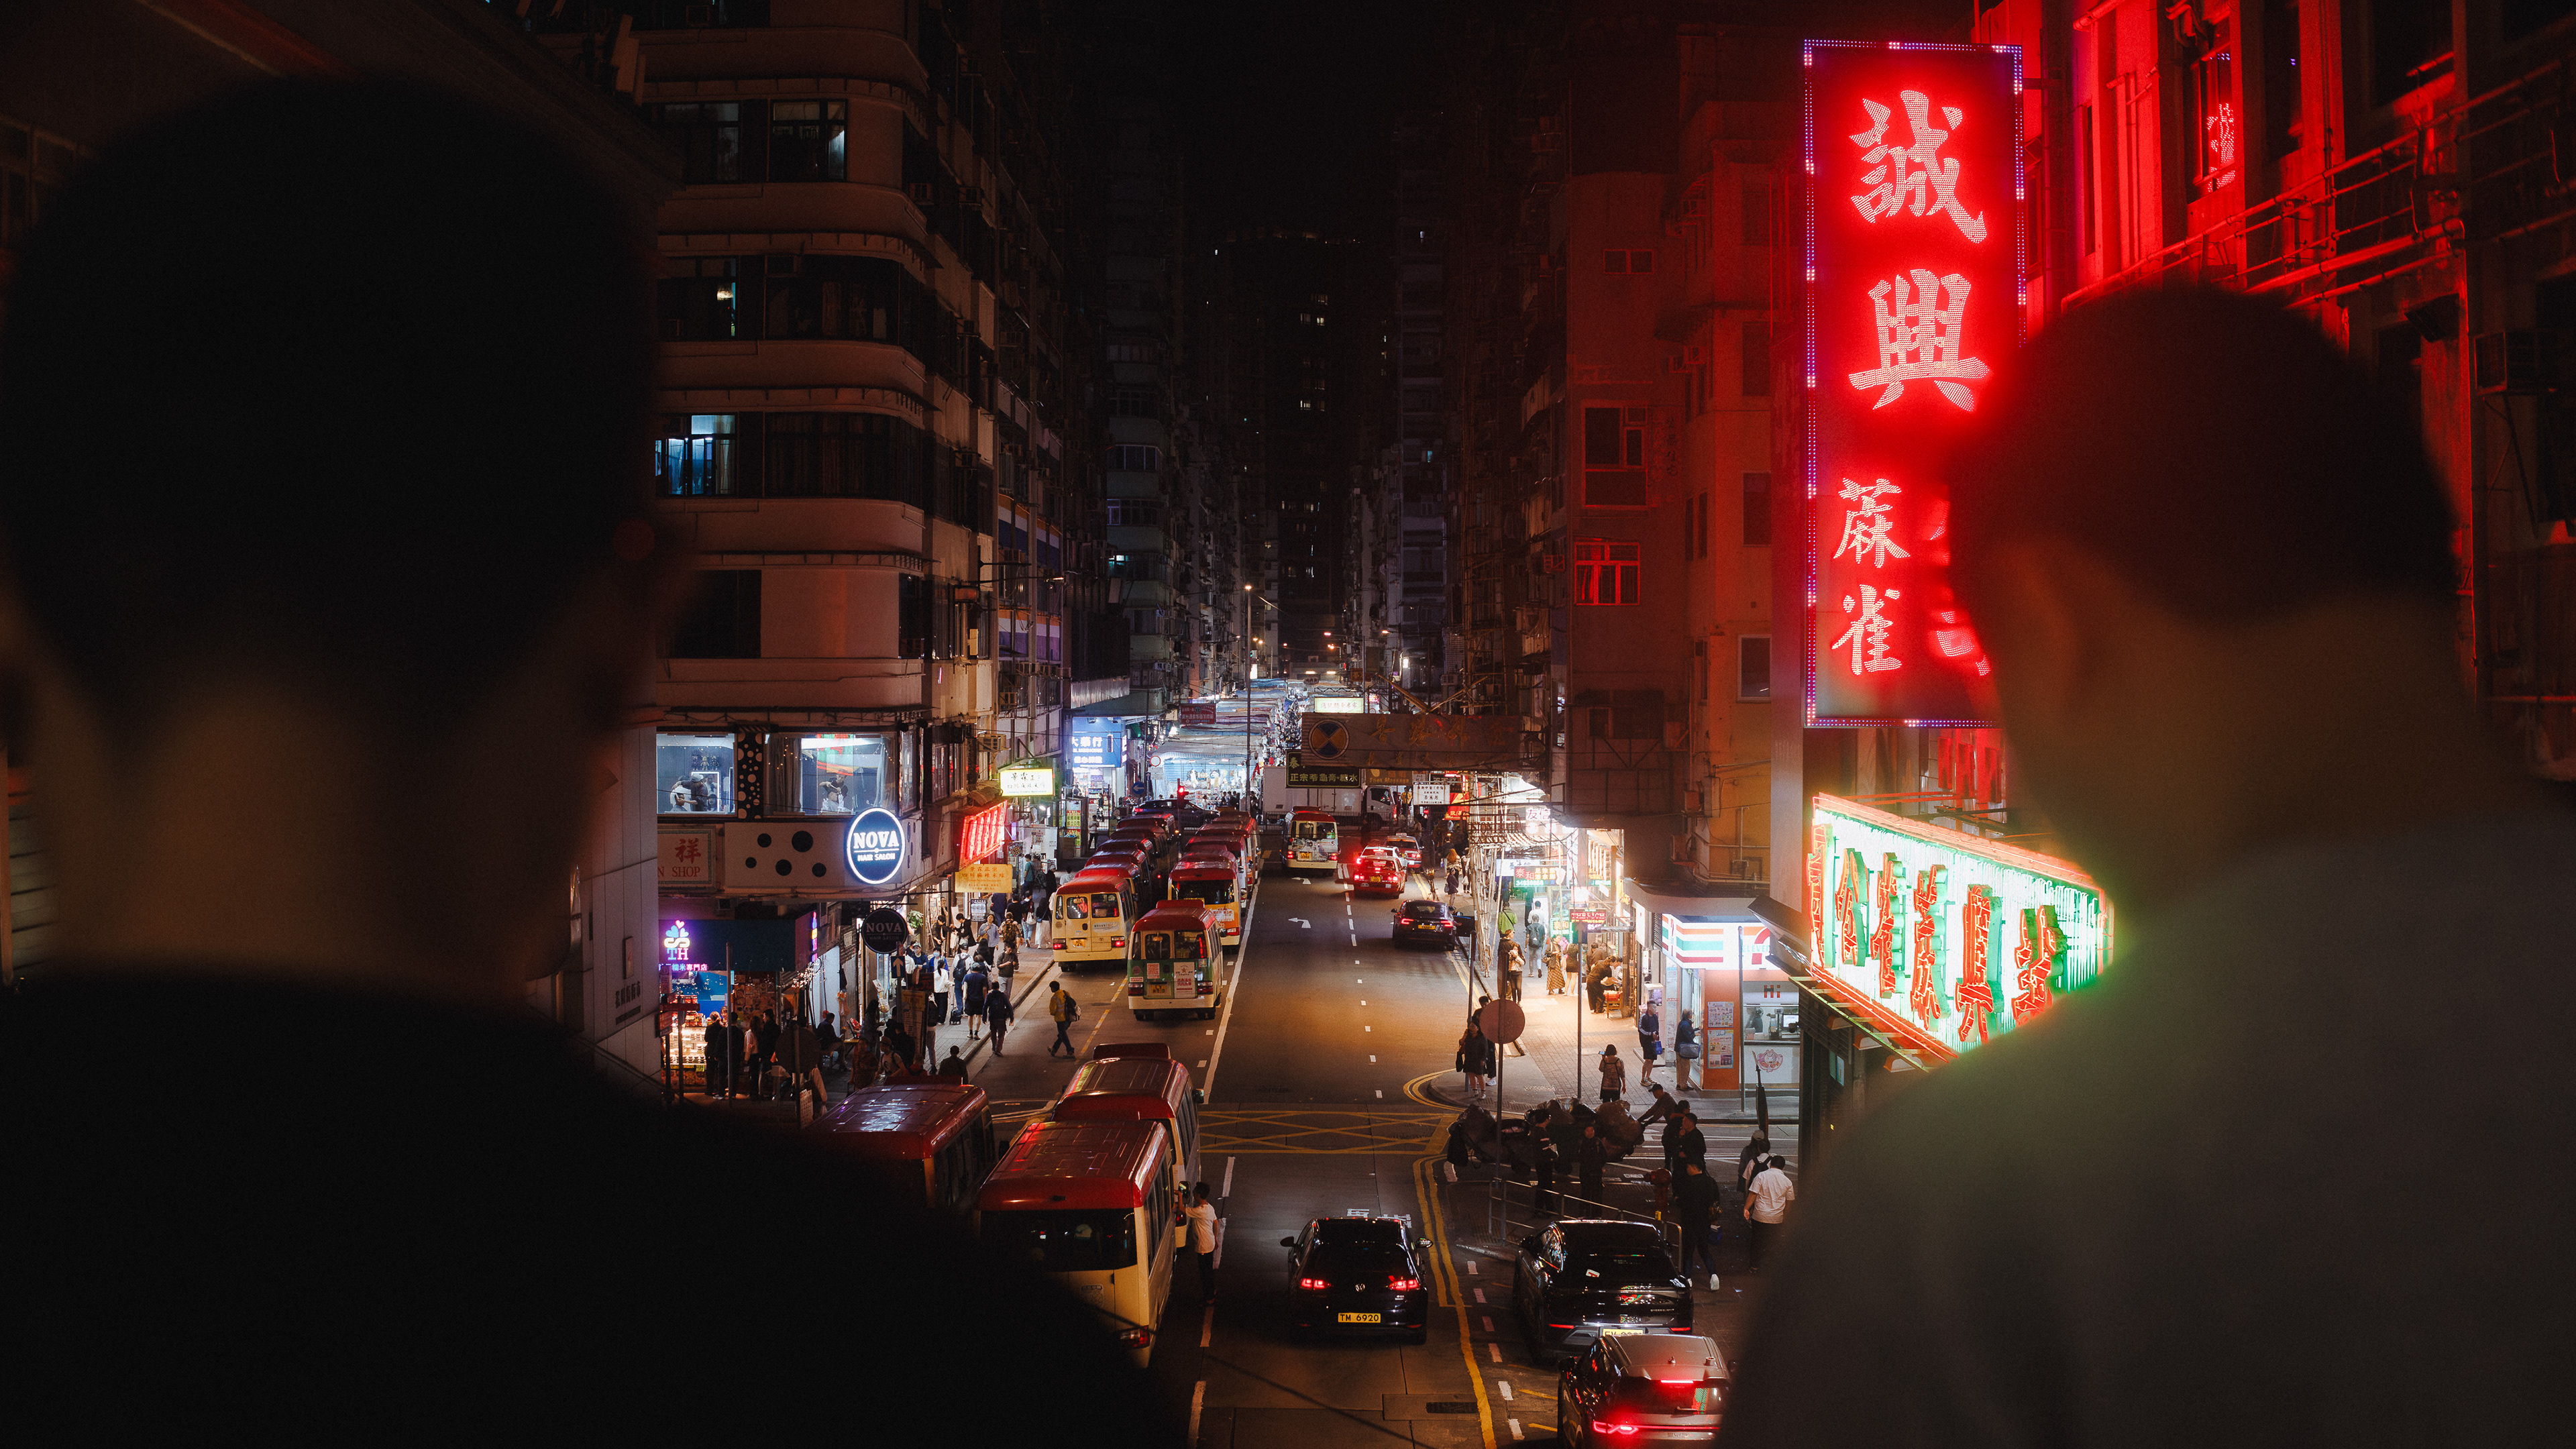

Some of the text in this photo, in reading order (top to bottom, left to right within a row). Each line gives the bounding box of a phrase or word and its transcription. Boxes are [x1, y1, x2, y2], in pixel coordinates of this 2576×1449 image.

[1849, 89, 1992, 412] 誠興
[853, 830, 900, 849] NOVA
[674, 837, 702, 864] 祥
[857, 853, 896, 861] HAIR SALON
[672, 866, 700, 877] SHOP
[865, 922, 902, 932] NOVA
[1764, 984, 1780, 998] Hi
[1356, 1313, 1379, 1322] 6920
